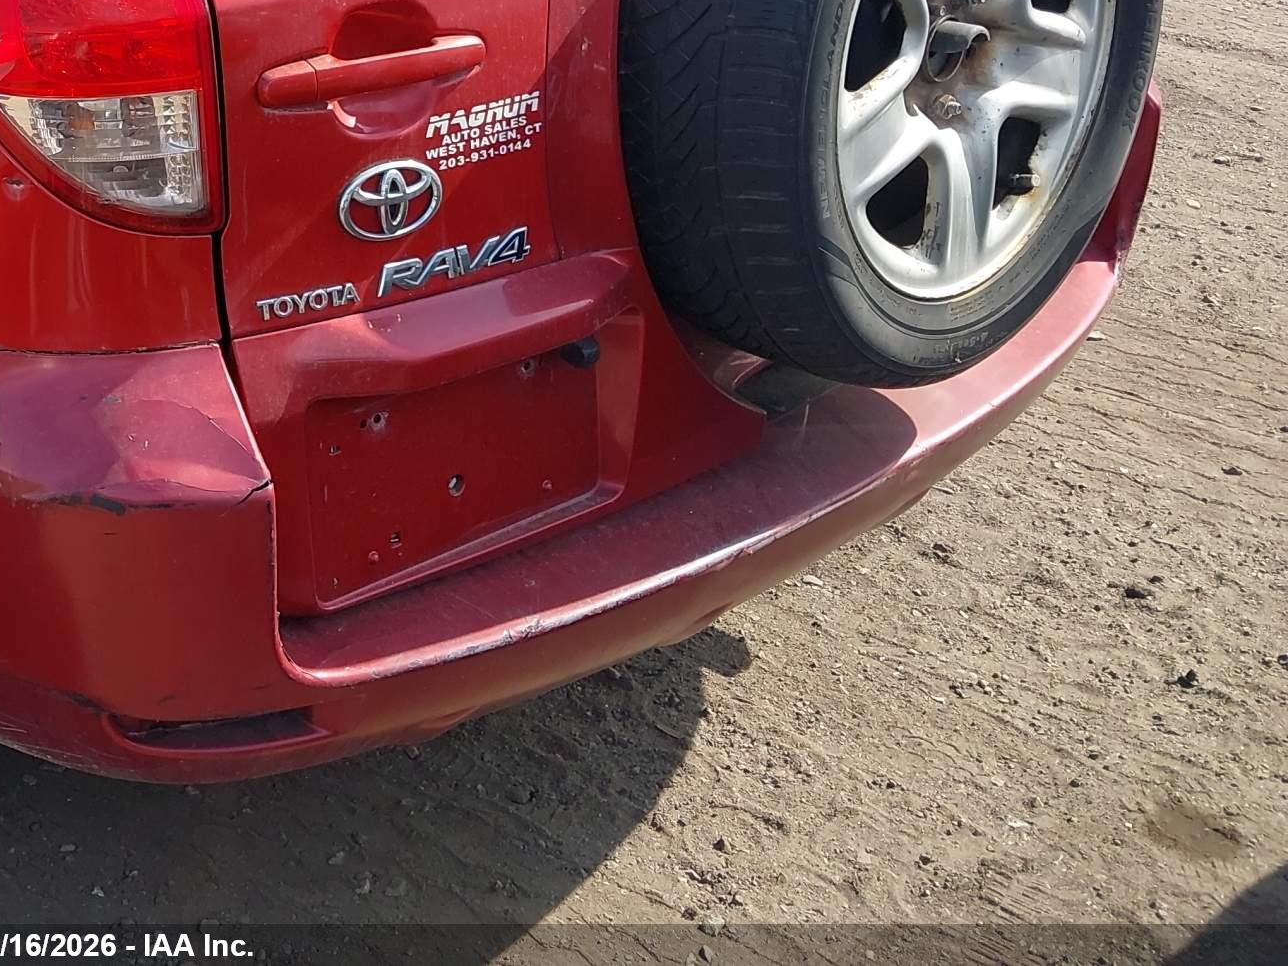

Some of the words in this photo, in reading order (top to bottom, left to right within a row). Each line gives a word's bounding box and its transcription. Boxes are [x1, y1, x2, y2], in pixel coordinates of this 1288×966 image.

[425, 90, 541, 139] MAGNUM
[442, 127, 480, 146] AUTO
[484, 115, 527, 135] SALES
[425, 141, 466, 160] WEST
[470, 128, 521, 149] HAVEN,
[524, 122, 543, 135] CT
[438, 138, 532, 171] 203-931-0144
[255, 282, 361, 321] TOYOTA
[377, 226, 531, 299] RAV4
